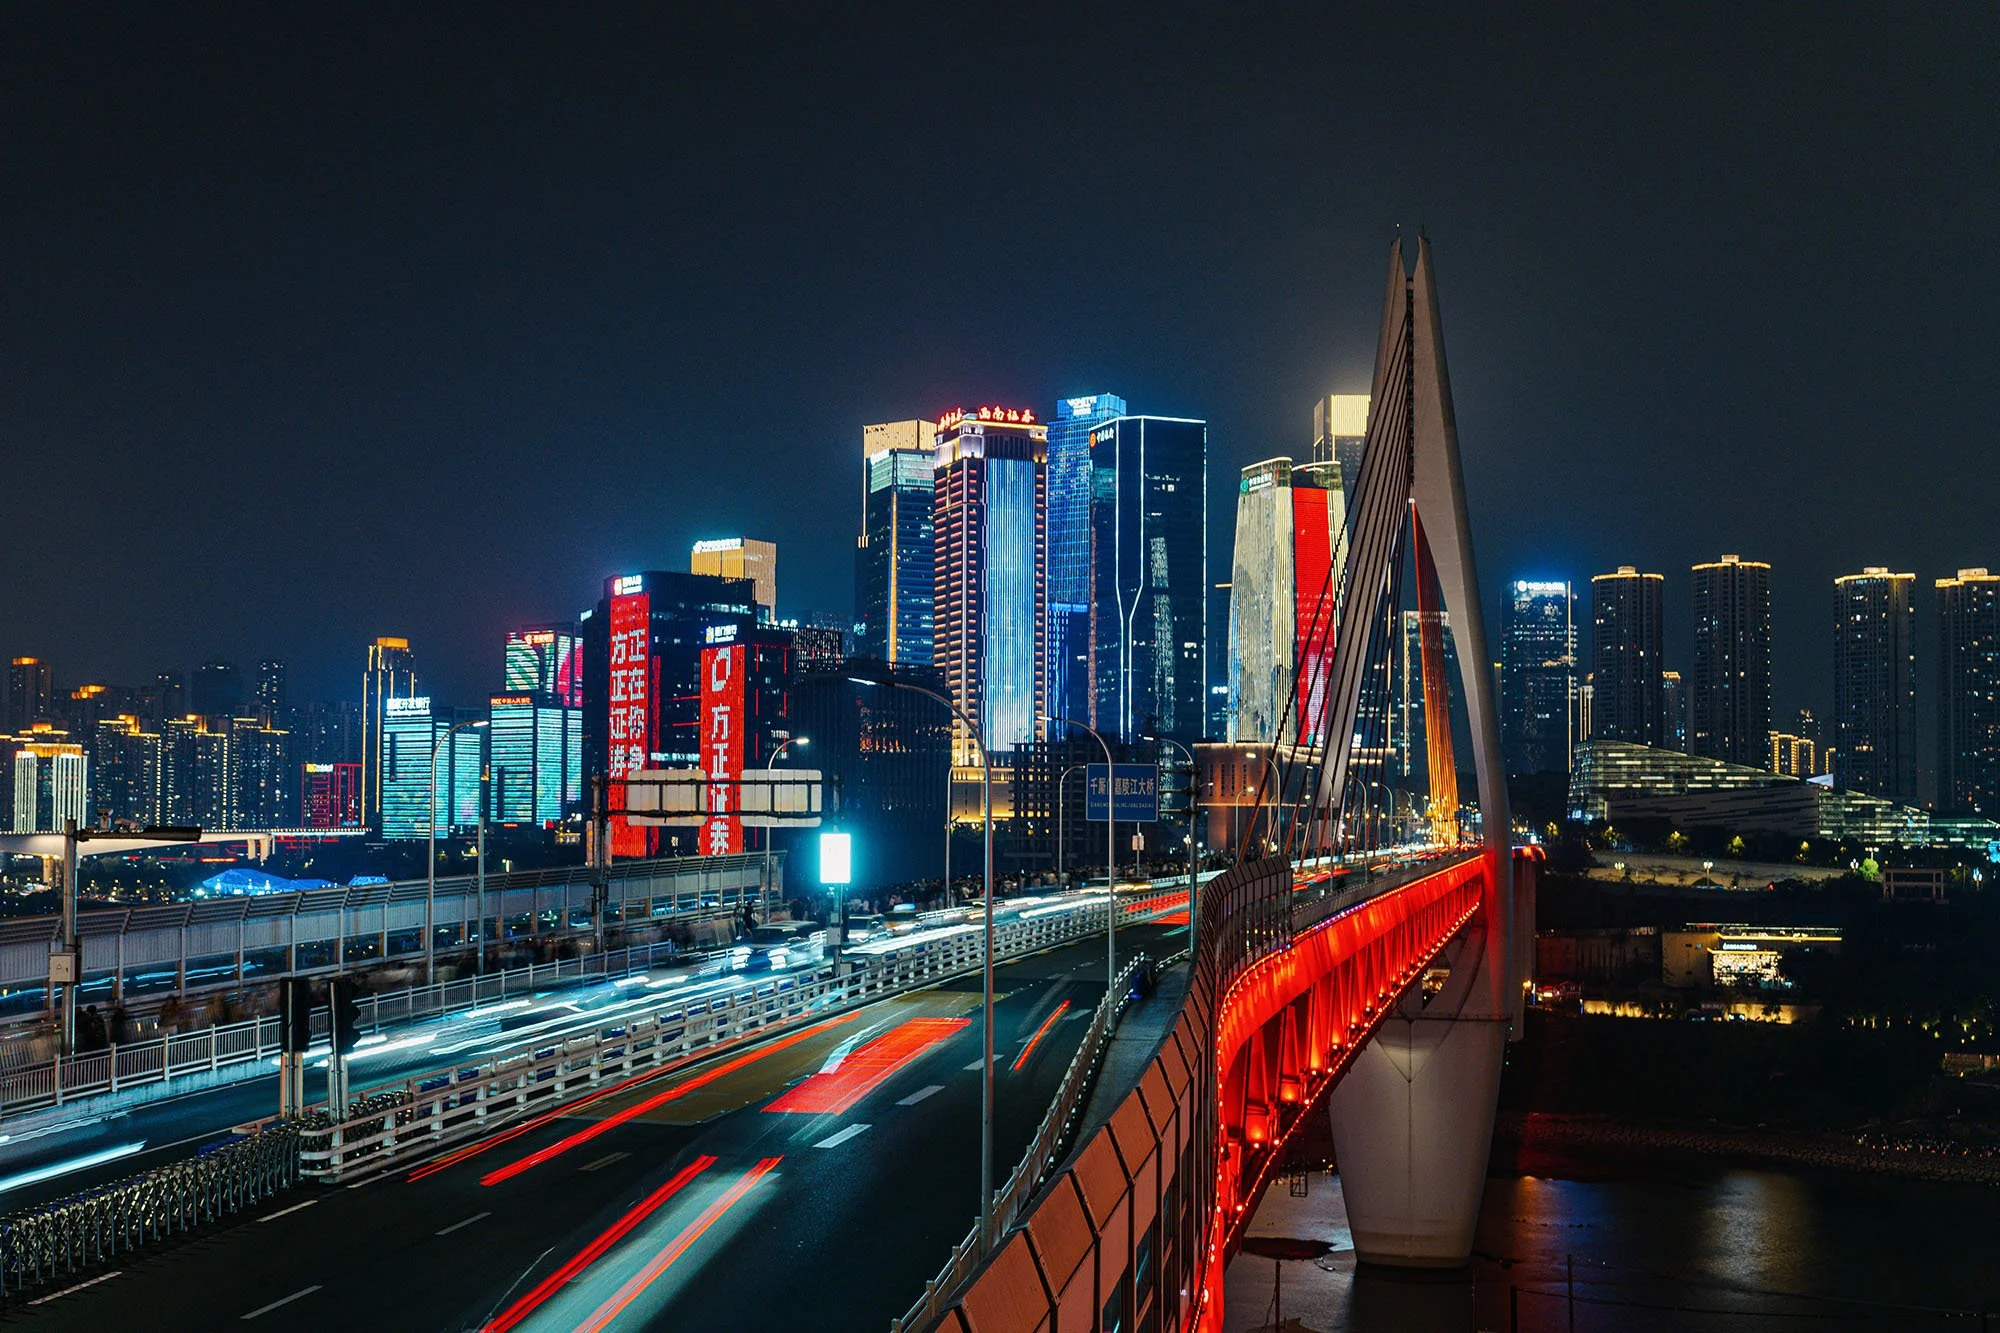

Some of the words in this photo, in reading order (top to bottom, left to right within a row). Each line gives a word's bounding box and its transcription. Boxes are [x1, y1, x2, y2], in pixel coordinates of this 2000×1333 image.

[1090, 777, 1155, 796] 千厮嘉陵江大桥
